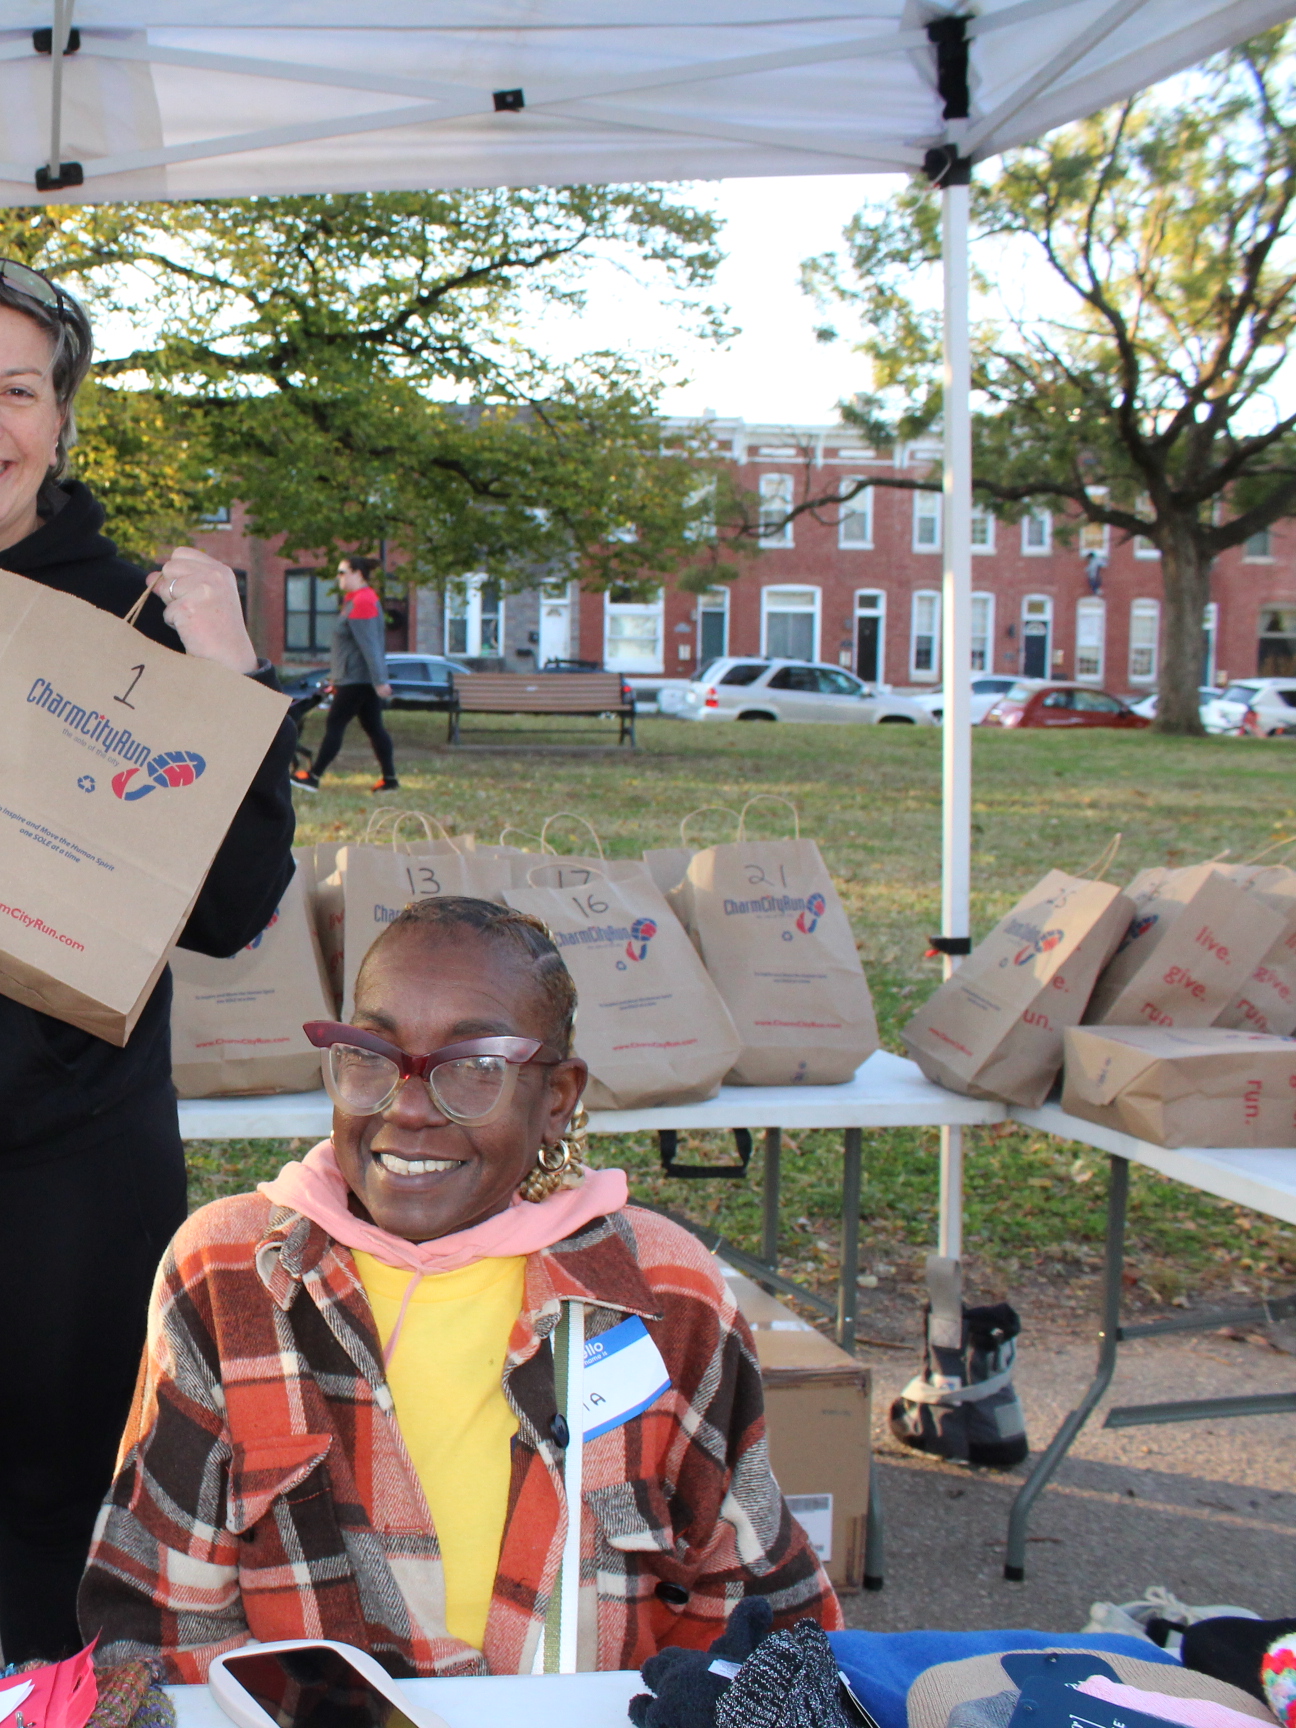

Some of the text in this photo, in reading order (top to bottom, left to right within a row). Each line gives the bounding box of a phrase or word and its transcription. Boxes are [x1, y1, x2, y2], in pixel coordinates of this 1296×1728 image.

[113, 664, 145, 710] 1
[26, 678, 151, 767] CharmCityRun
[62, 728, 74, 739] the
[107, 756, 120, 767] city
[2, 807, 27, 823] Inspire
[25, 819, 41, 831] and
[39, 826, 60, 840] Move
[58, 836, 72, 848] the
[71, 843, 96, 861] Human
[95, 857, 115, 872] Spirit
[19, 828, 34, 838] one
[32, 834, 52, 848] SOLE
[50, 844, 60, 852] at
[64, 851, 82, 864] time
[406, 867, 441, 896] 13
[558, 869, 591, 889] 17
[744, 864, 788, 888] 21
[572, 894, 609, 919] 16
[723, 895, 805, 915] CharmCityRun
[1195, 926, 1231, 965] live.
[1162, 966, 1207, 1003] give.
[1023, 1008, 1054, 1032] un.
[1244, 1080, 1262, 1126] run.
